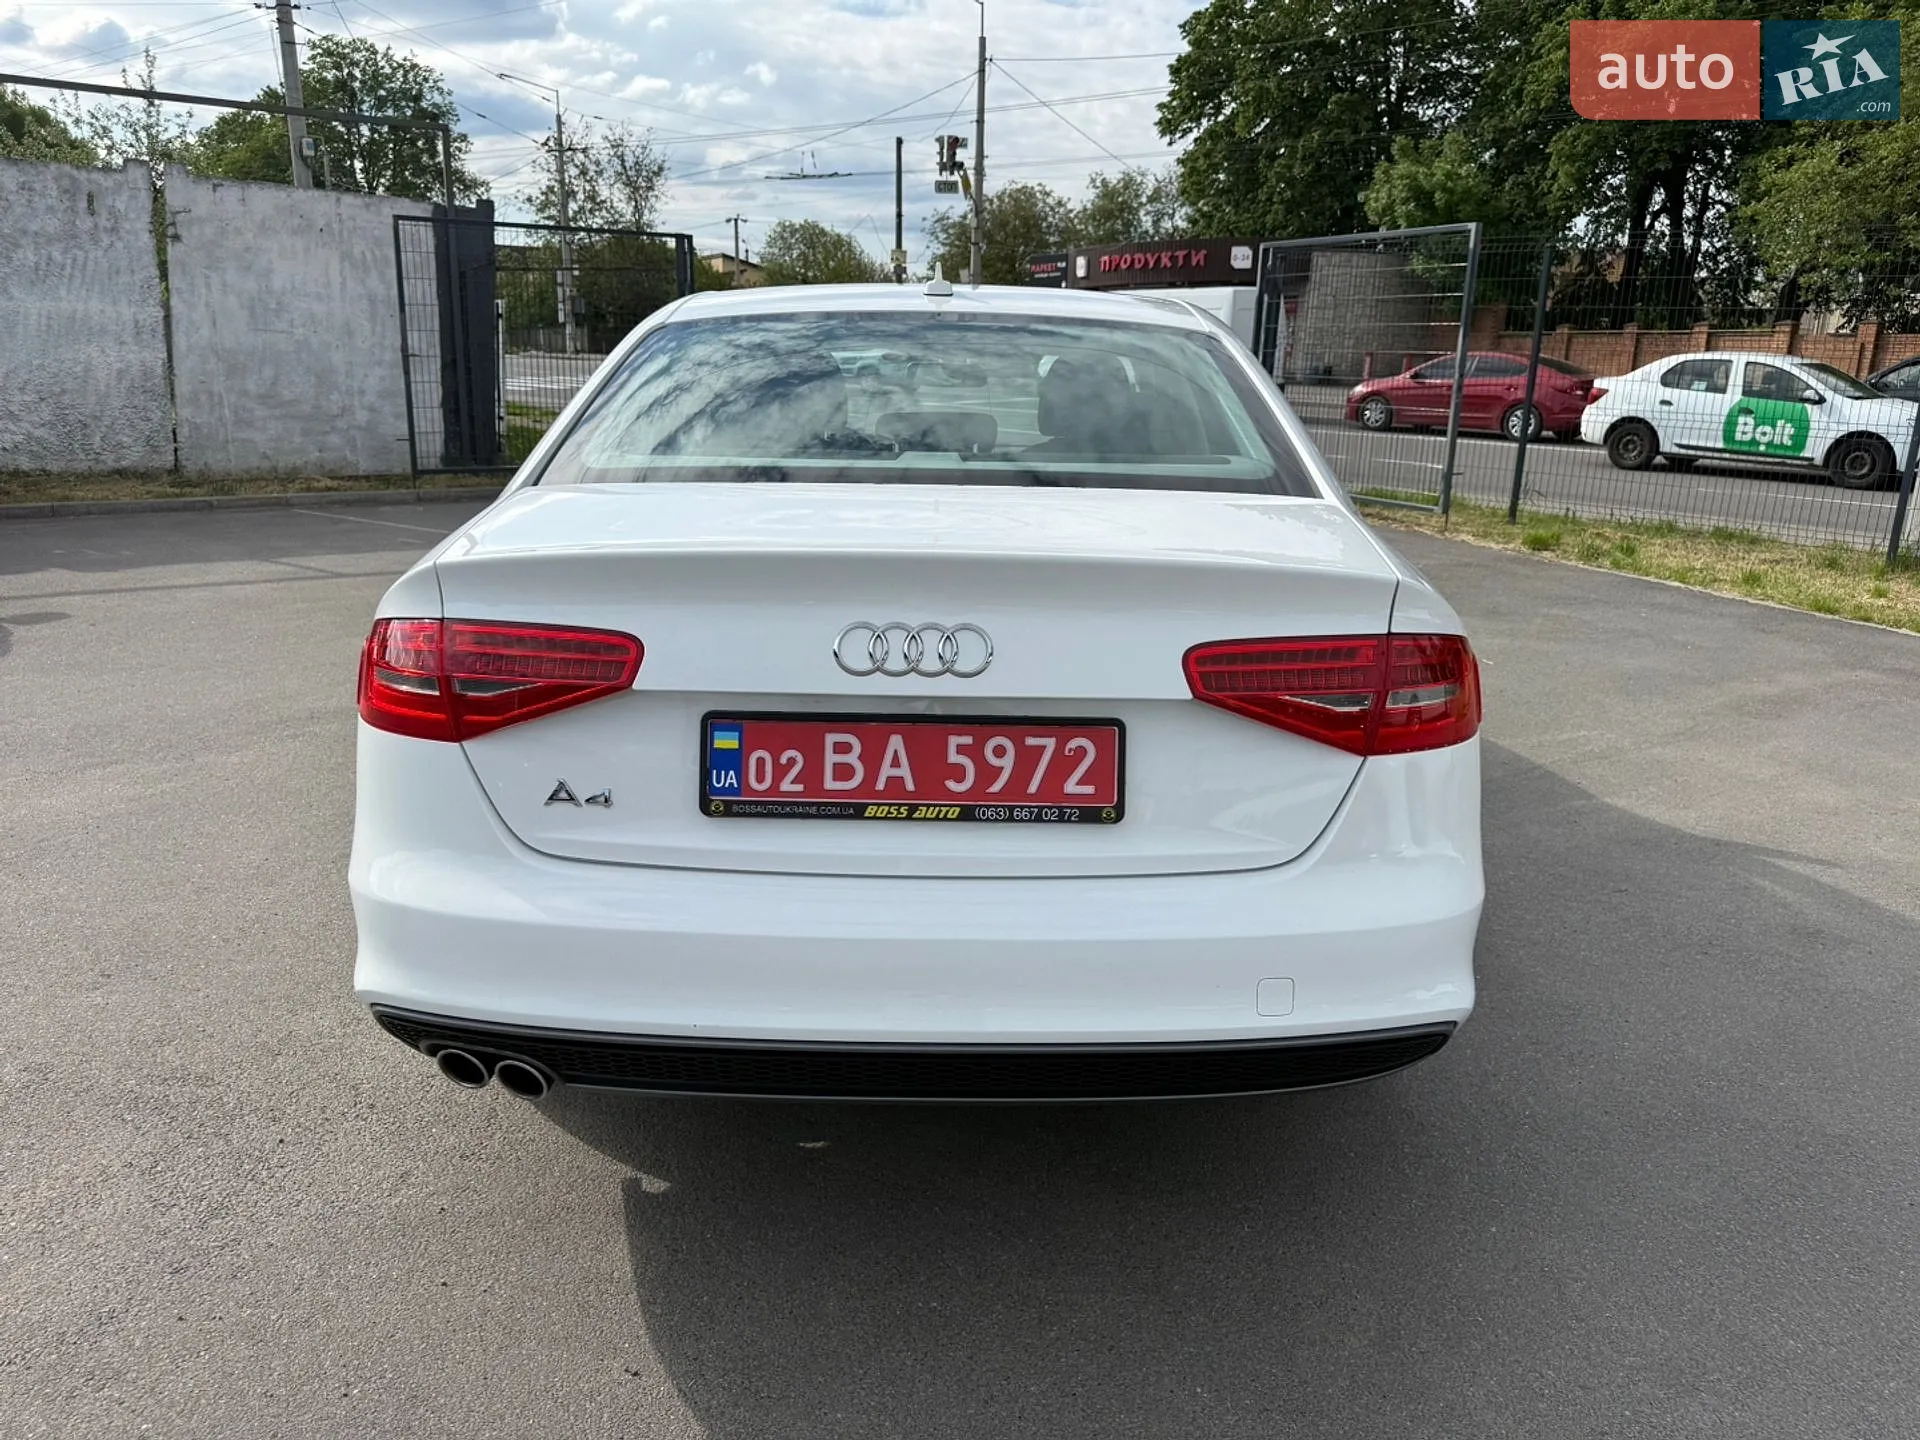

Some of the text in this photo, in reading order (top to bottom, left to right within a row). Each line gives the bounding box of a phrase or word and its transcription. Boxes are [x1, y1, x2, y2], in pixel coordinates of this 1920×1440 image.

[1735, 415, 1795, 450] Bolt
[748, 733, 1097, 795] 02 BA 5972
[712, 769, 738, 788] UA
[543, 778, 613, 808] A4
[864, 805, 909, 817] BOSS
[975, 807, 1080, 821] (063) 667 02 72
